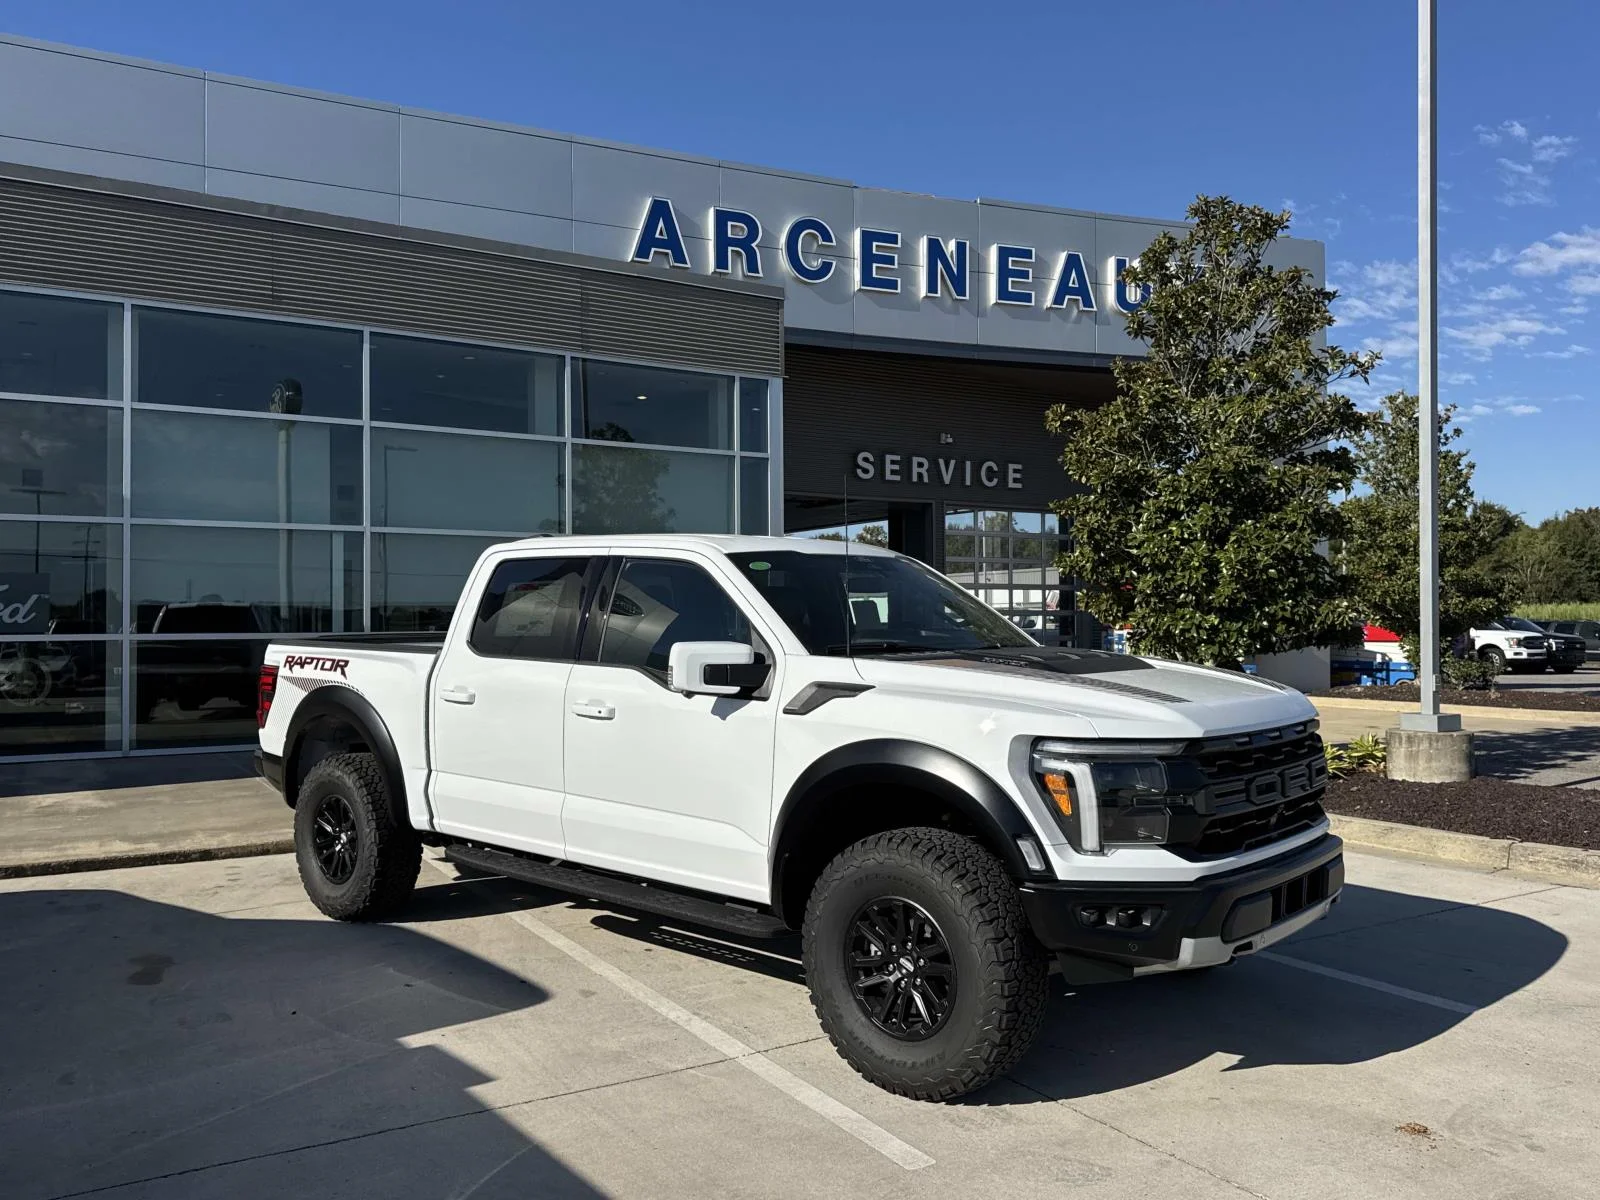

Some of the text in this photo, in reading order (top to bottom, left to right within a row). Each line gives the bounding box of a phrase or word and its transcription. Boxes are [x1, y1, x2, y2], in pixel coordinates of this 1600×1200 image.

[628, 196, 1212, 313] ARCENEAU
[856, 451, 1023, 489] SERVICE
[283, 655, 349, 680] RAPTOR
[1192, 757, 1328, 816] FORD
